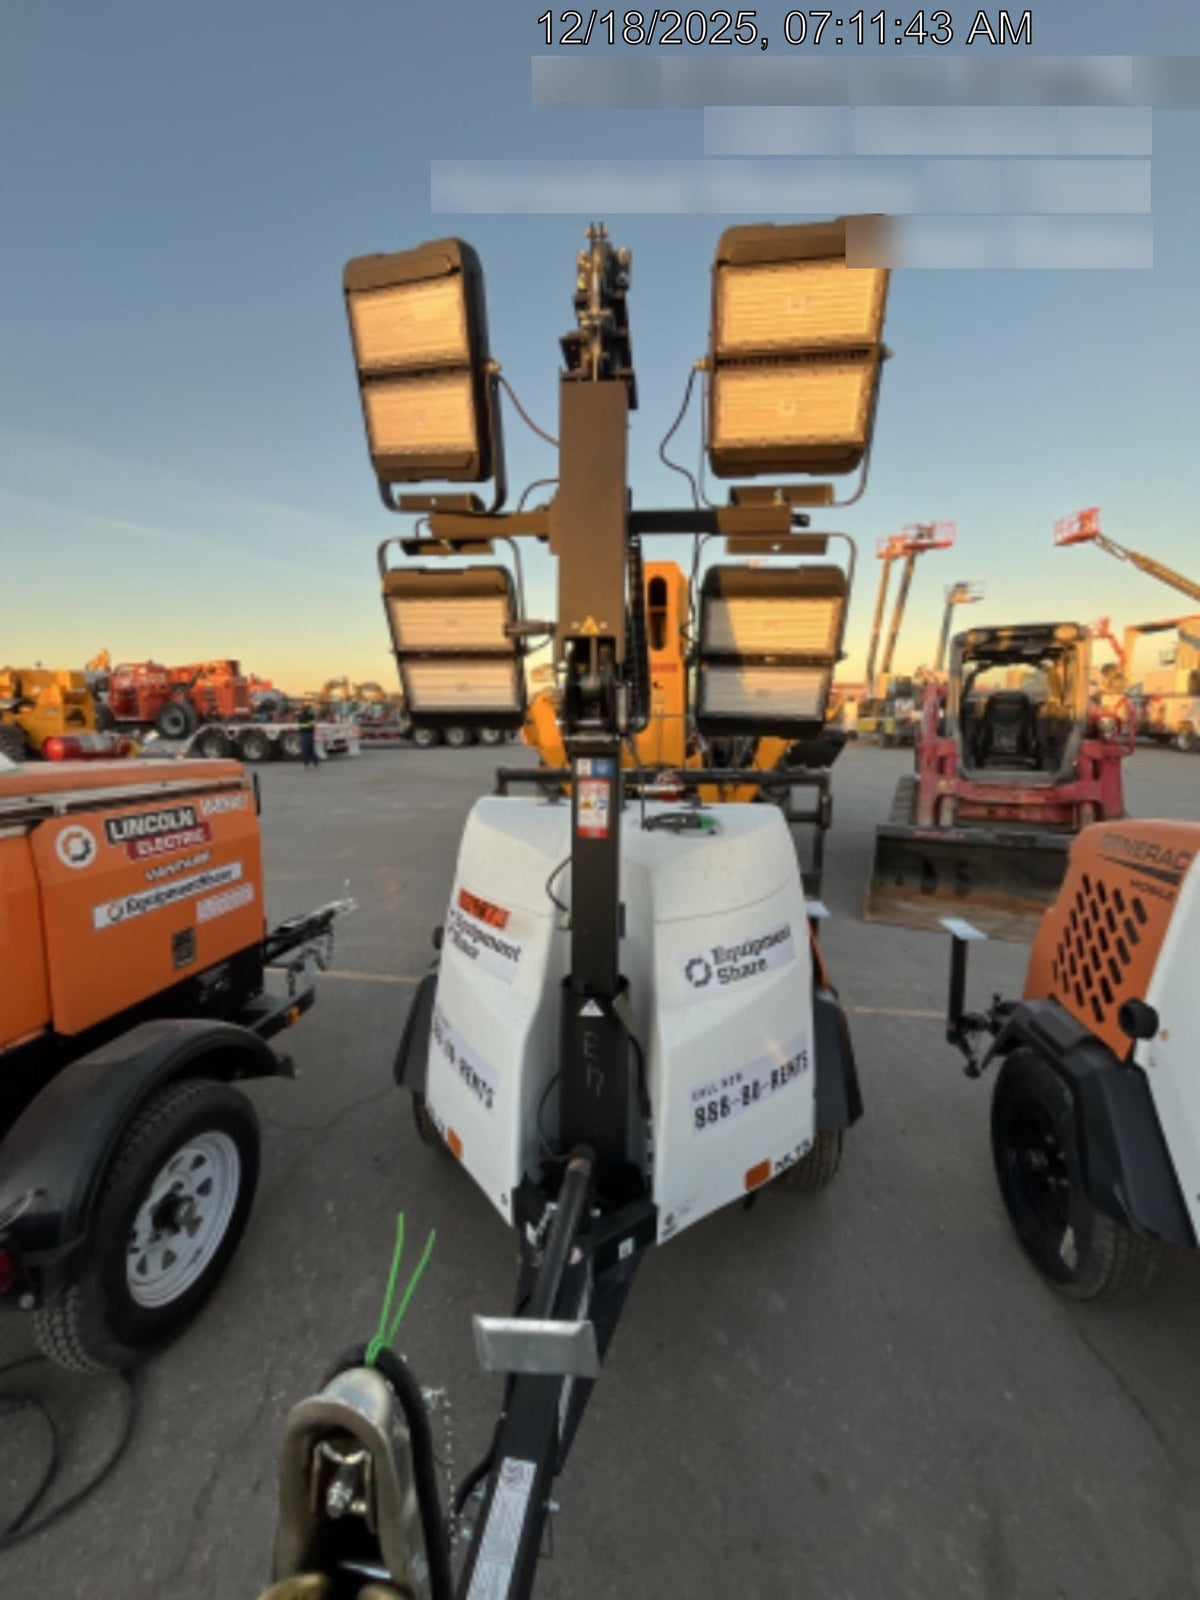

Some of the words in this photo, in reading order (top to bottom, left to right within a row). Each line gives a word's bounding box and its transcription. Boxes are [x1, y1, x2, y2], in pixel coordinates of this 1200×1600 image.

[109, 808, 195, 839] LINCOLN
[135, 827, 206, 855] ELECTRIC
[711, 924, 791, 965] Equipment
[716, 958, 768, 985] Share
